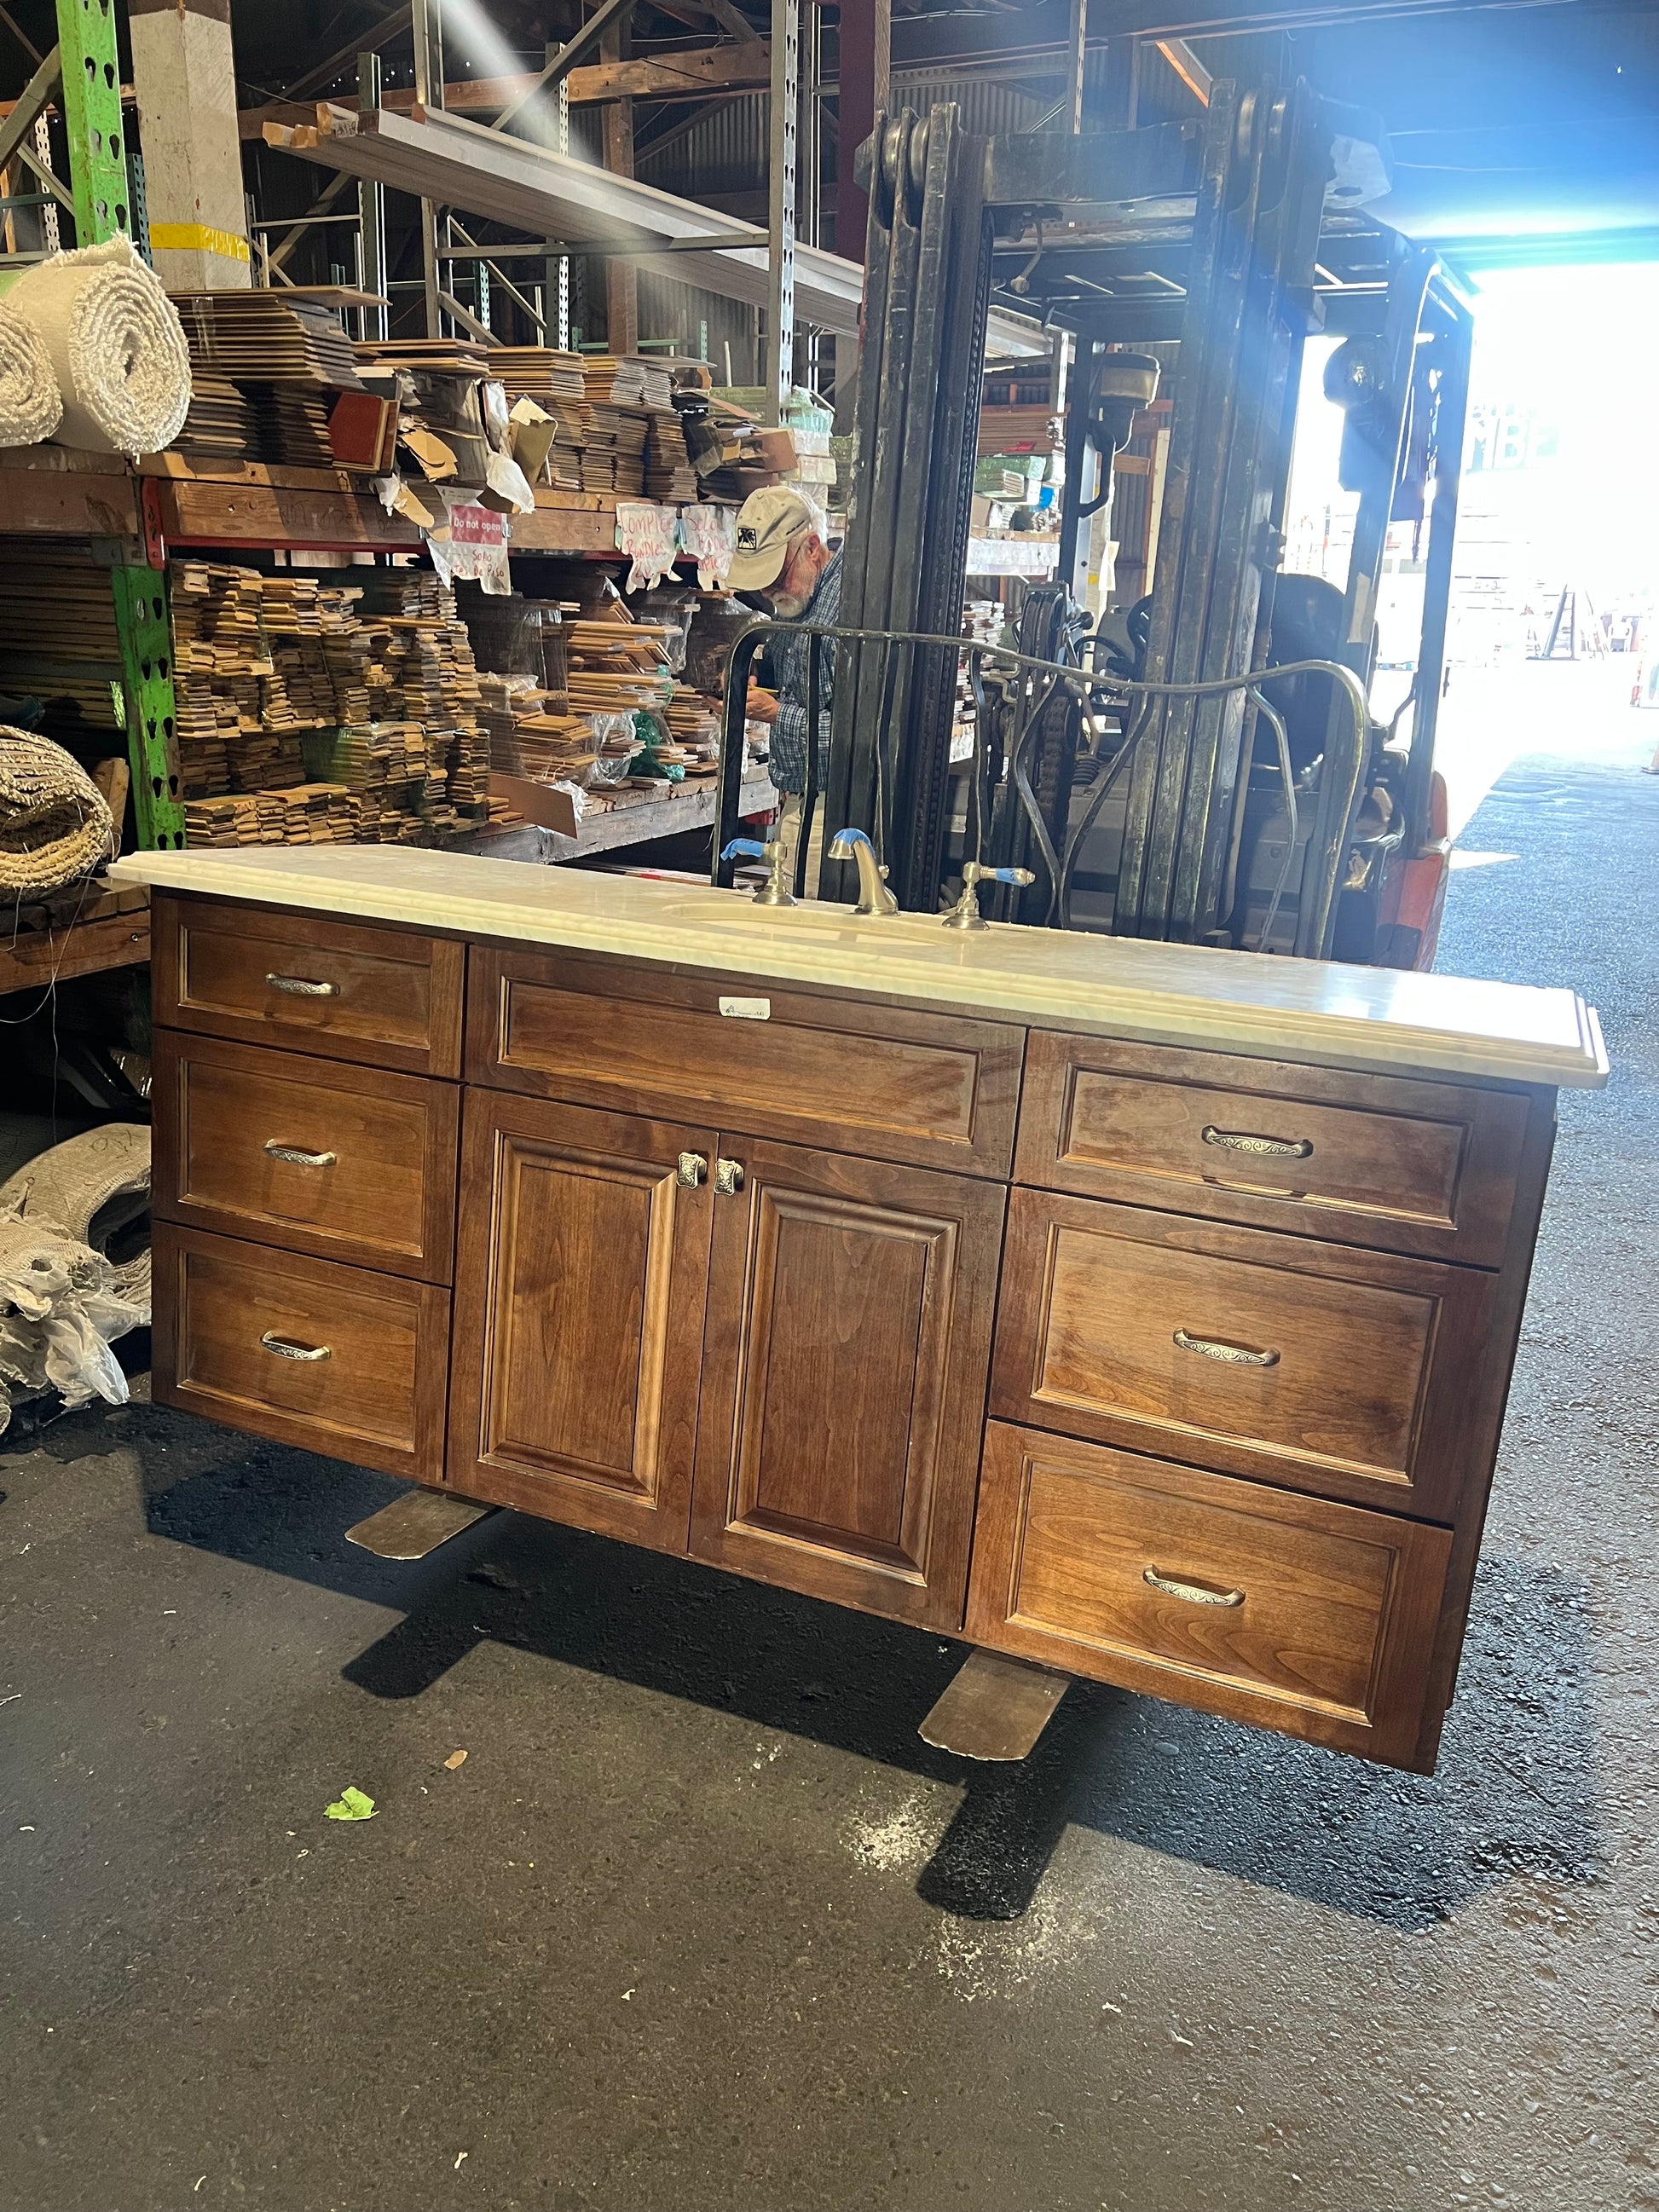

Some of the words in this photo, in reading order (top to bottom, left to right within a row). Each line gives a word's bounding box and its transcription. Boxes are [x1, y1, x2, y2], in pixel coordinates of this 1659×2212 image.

[454, 517, 465, 528] Do
[465, 519, 479, 529] not
[481, 522, 500, 533] open
